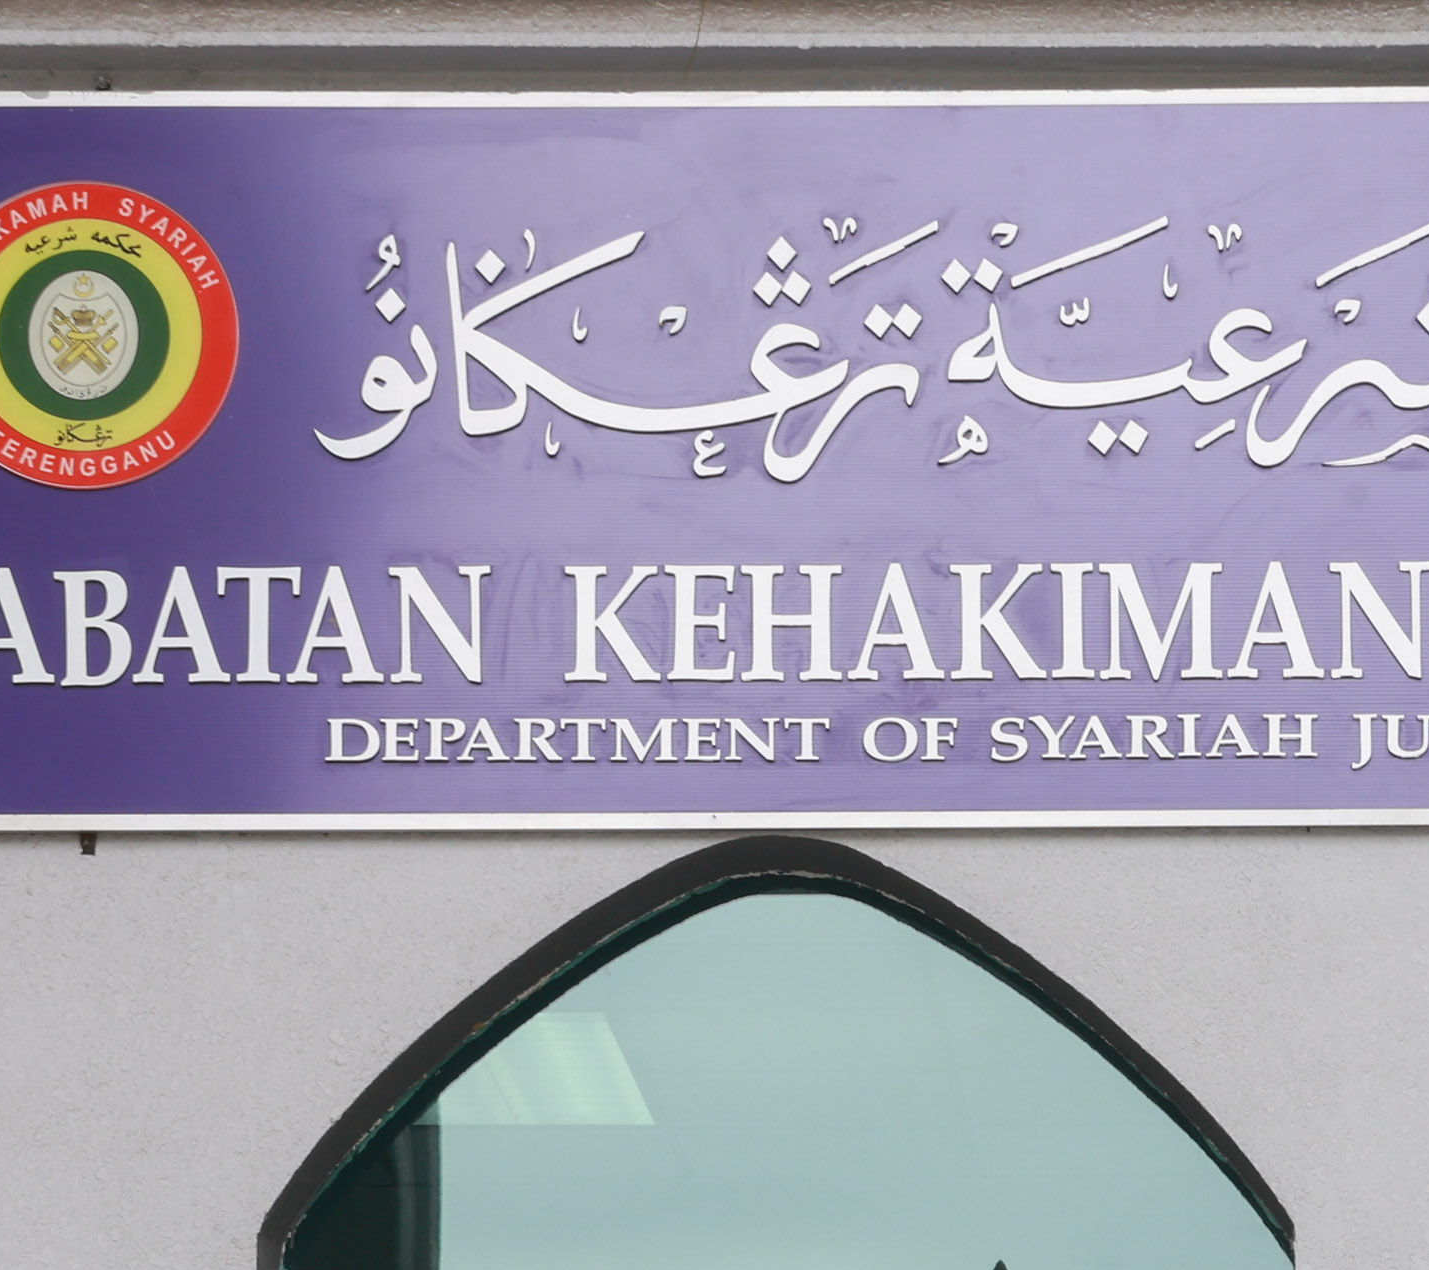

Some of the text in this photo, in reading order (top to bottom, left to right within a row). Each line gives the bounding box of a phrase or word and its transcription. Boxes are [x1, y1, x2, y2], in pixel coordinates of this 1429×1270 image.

[117, 197, 220, 290] SYARIAH
[324, 716, 830, 763] DEPARTMENT
[863, 716, 958, 762] OF
[989, 713, 1319, 762] SYARIAH
